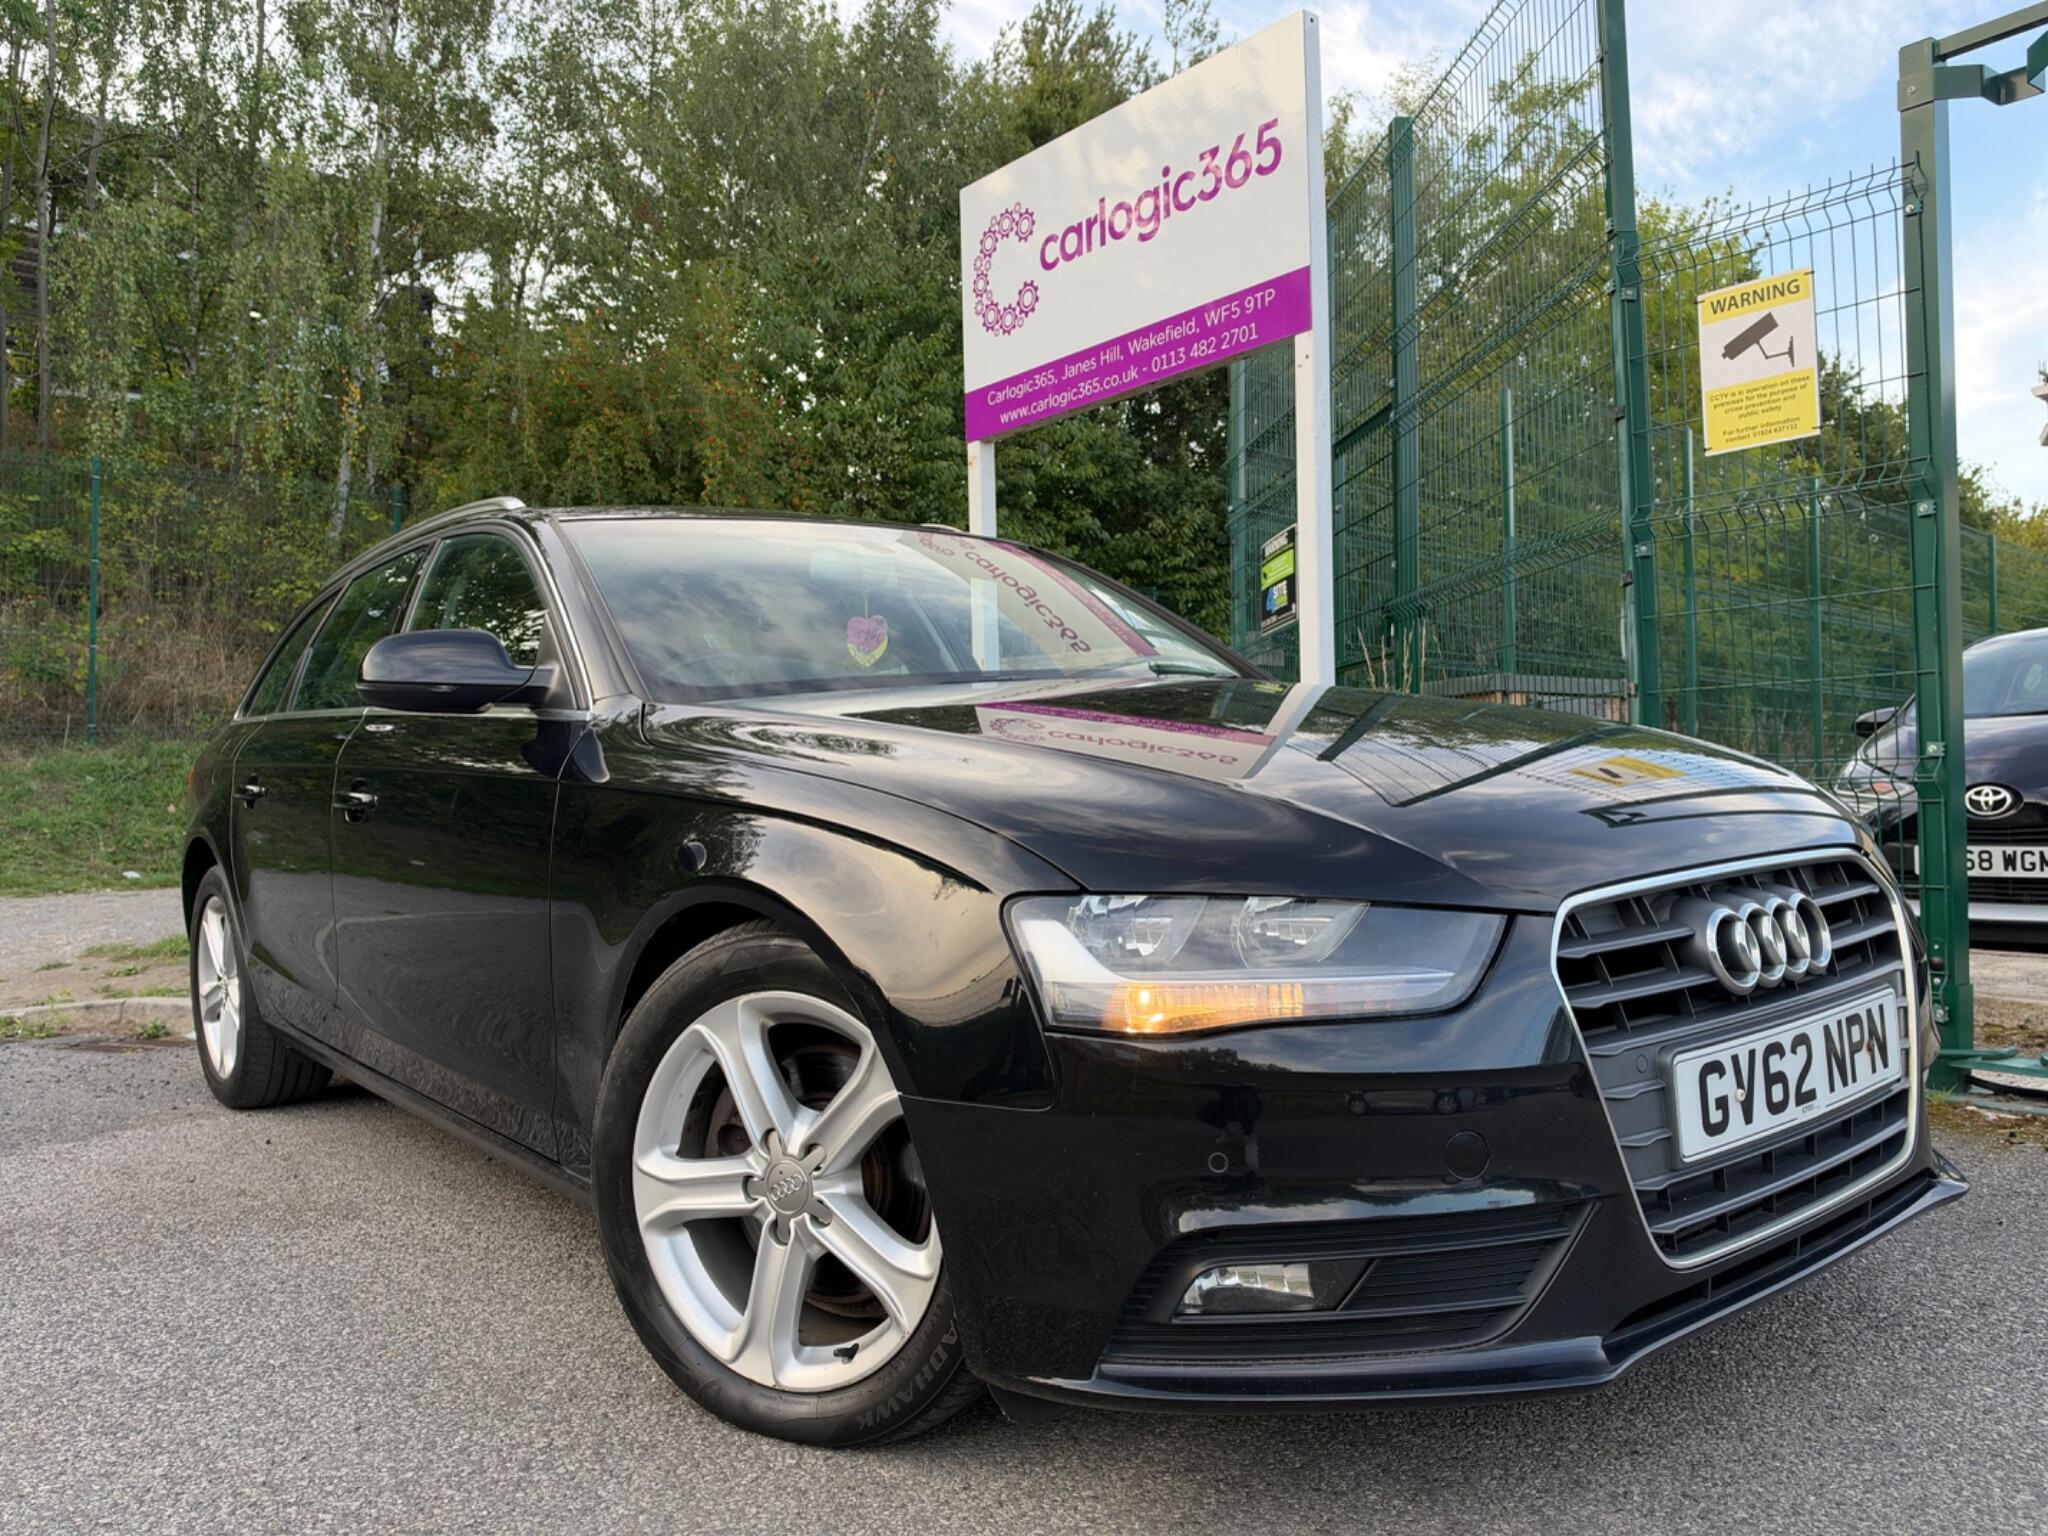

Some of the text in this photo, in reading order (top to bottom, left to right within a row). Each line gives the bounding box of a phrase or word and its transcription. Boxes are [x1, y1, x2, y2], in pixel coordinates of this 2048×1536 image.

[1040, 118, 1282, 271] carlogic365
[1710, 279, 1800, 315] WARNING
[987, 287, 1276, 405] Carlogic365, Janes Hill, Wakefield, WF5 9TP
[999, 364, 1139, 424] www.carlogic365.co.uk
[1151, 349, 1186, 373] 0113
[1190, 336, 1217, 360] 482
[1221, 322, 1258, 350] 2701
[1710, 391, 1729, 402] CCTV
[1746, 381, 1778, 394] operation
[1791, 375, 1810, 383] these
[1713, 382, 1807, 410] premises for the purpose of
[1724, 393, 1796, 414] crime prevention and
[1738, 404, 1782, 419] public safety
[1724, 432, 1751, 443] contact
[1736, 424, 1759, 434] further
[1760, 416, 1801, 428] information
[1698, 1002, 1889, 1137] GV62 NPN
[855, 1311, 959, 1430] ADHAWK
